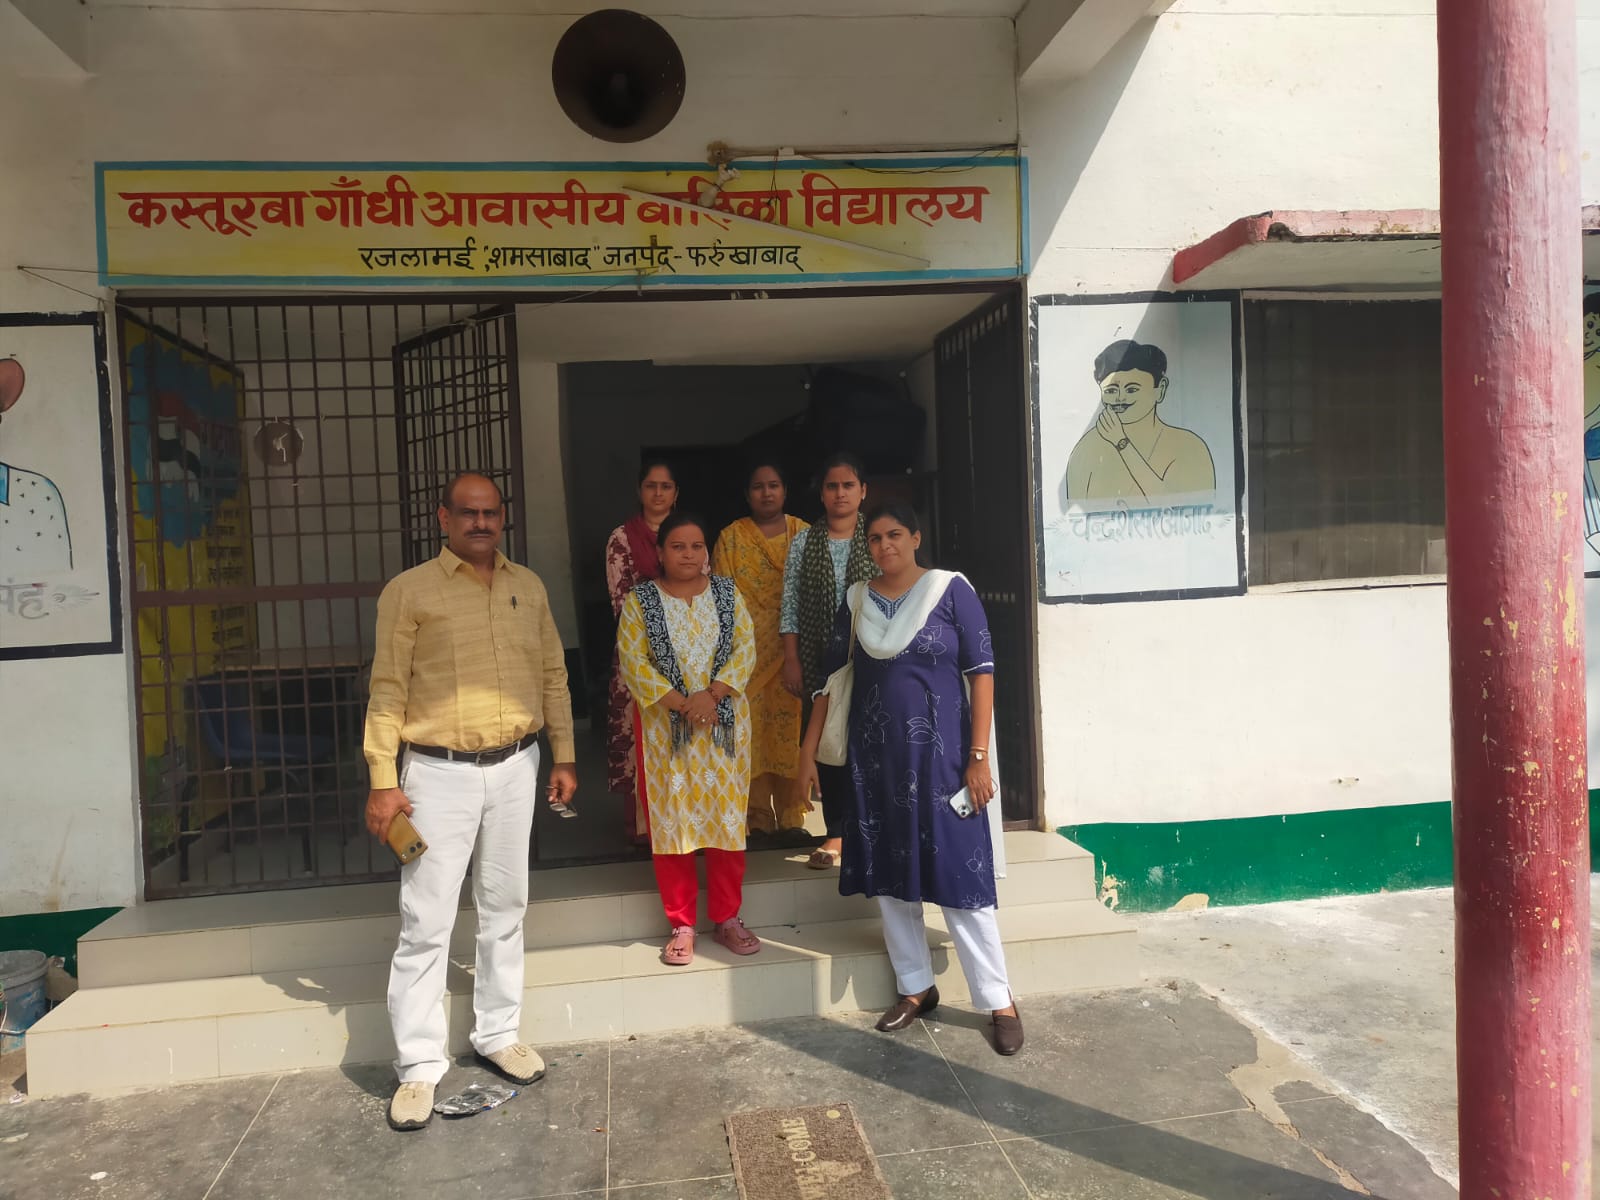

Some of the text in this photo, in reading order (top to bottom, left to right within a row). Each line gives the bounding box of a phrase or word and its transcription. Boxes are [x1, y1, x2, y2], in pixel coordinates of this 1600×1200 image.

[118, 190, 307, 237] कस्तूरबा
[310, 175, 419, 228] गाँधी
[421, 178, 631, 229] आवासीय
[797, 173, 991, 228] विद्यालय
